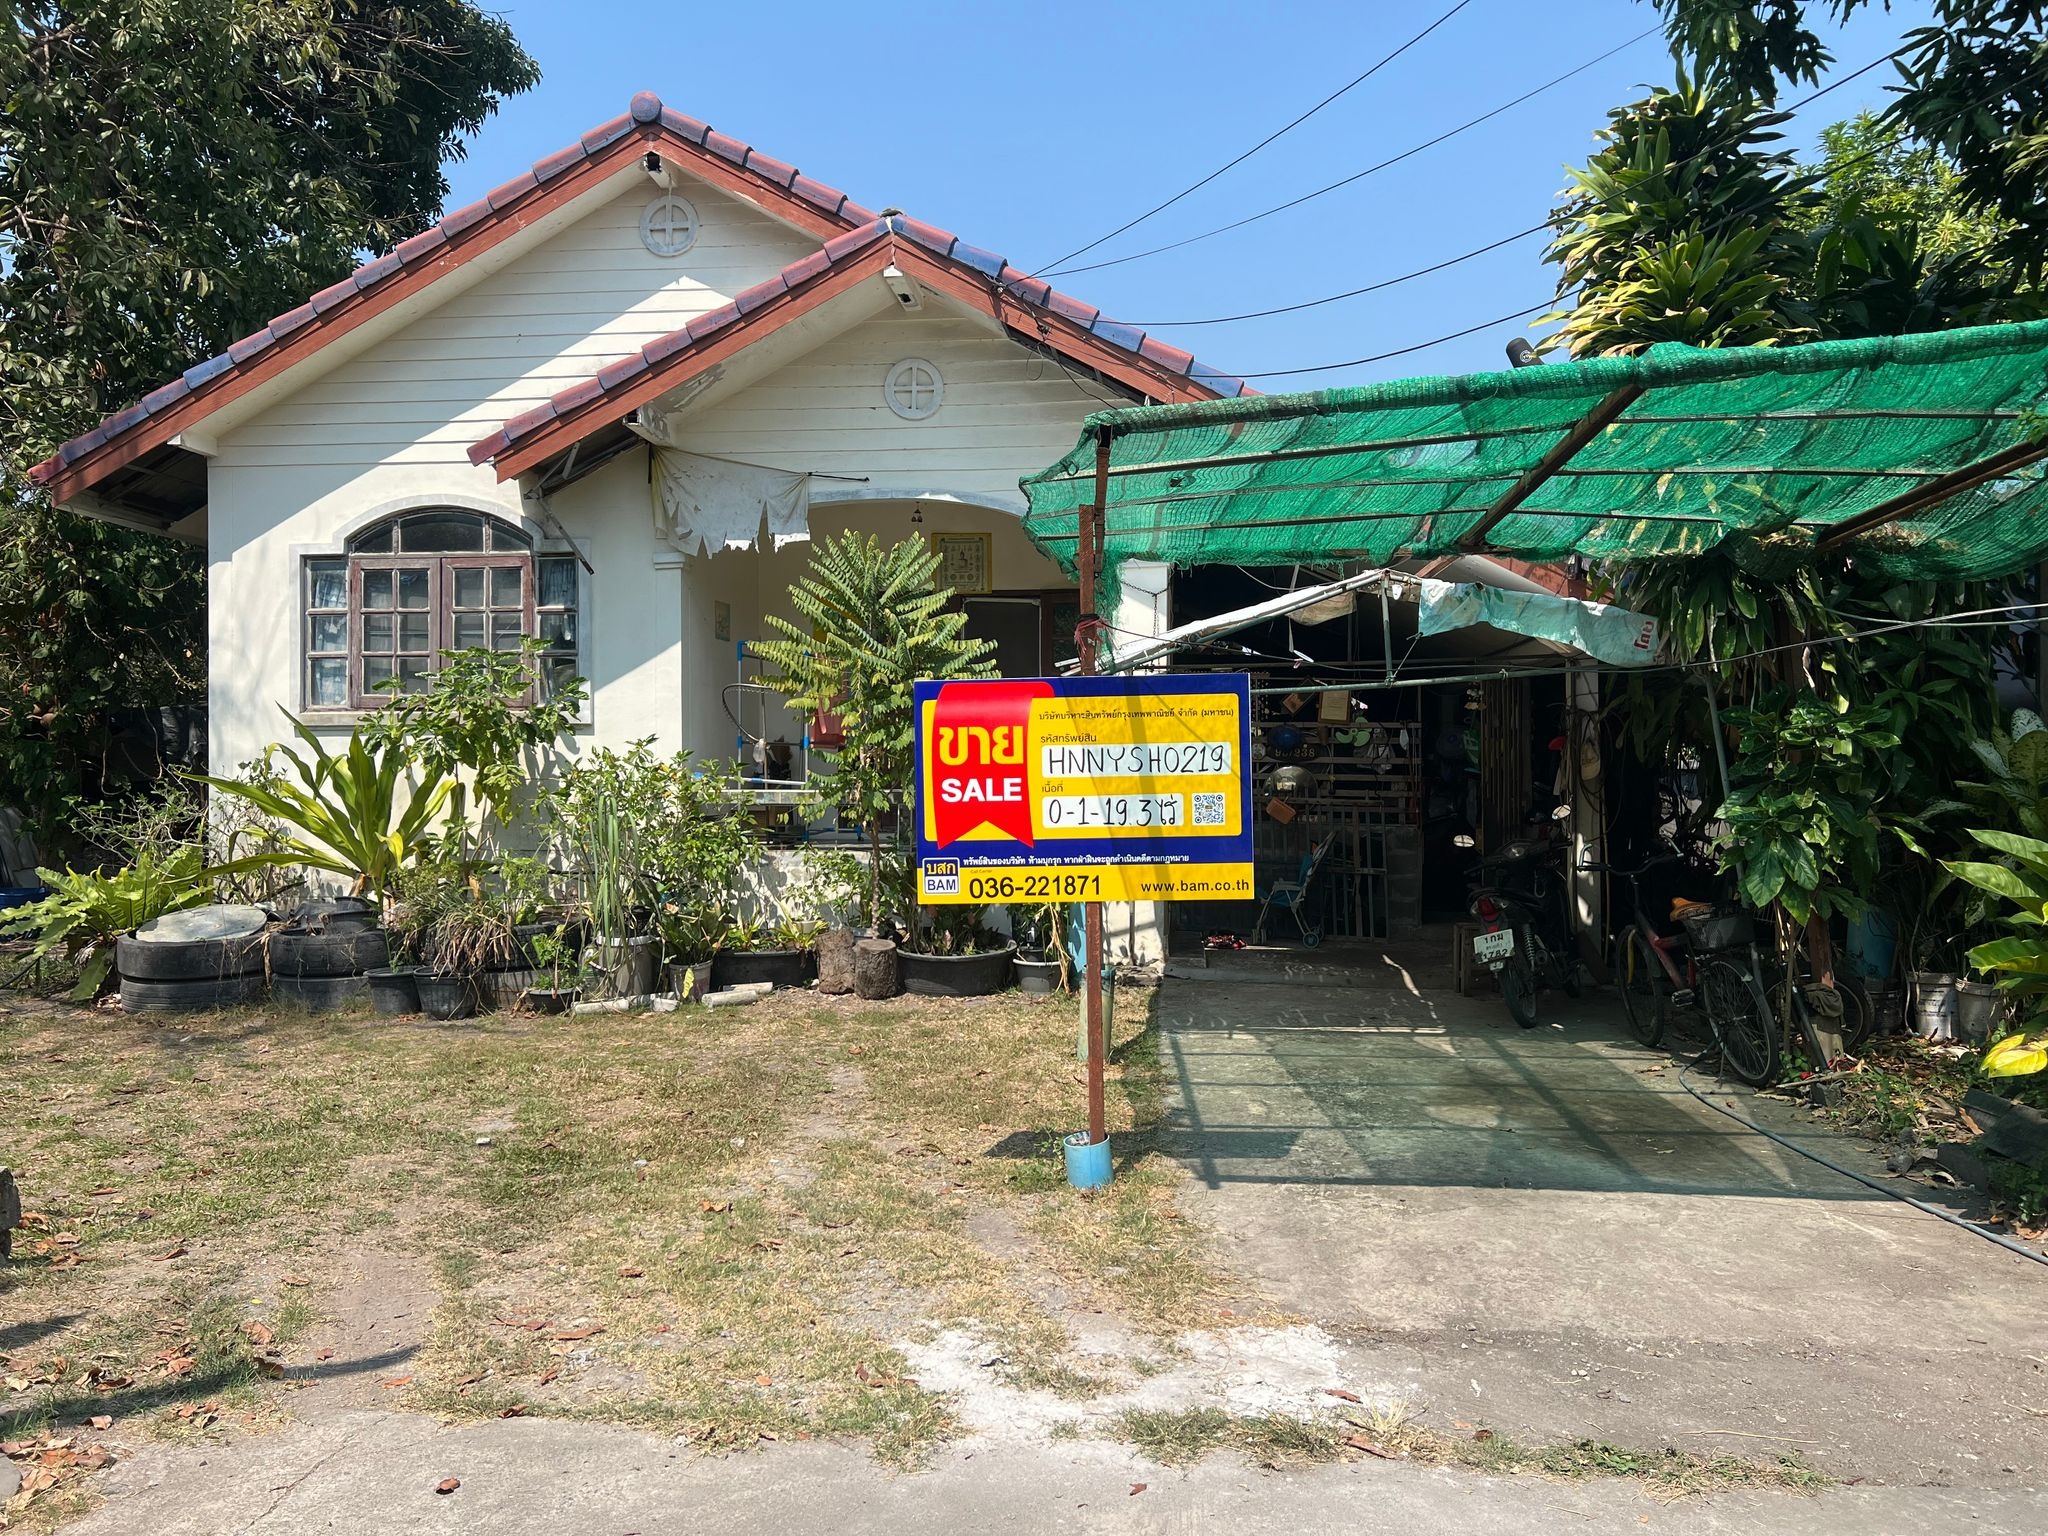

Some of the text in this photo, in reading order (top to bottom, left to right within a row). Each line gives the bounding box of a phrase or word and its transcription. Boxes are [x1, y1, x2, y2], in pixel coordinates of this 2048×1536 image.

[1178, 708, 1198, 717] จำกัด
[1201, 709, 1234, 718] (มหาชน)
[1040, 733, 1097, 744] รหัสทรัพย์สิน
[939, 725, 1024, 766] ขาย
[941, 777, 1023, 803] SALE
[1041, 781, 1064, 793] เนื้อที่
[926, 862, 956, 875] บสก
[927, 879, 956, 891] BAM
[969, 875, 1100, 899] 036-221871
[1141, 879, 1249, 892] www.bam.co.th
